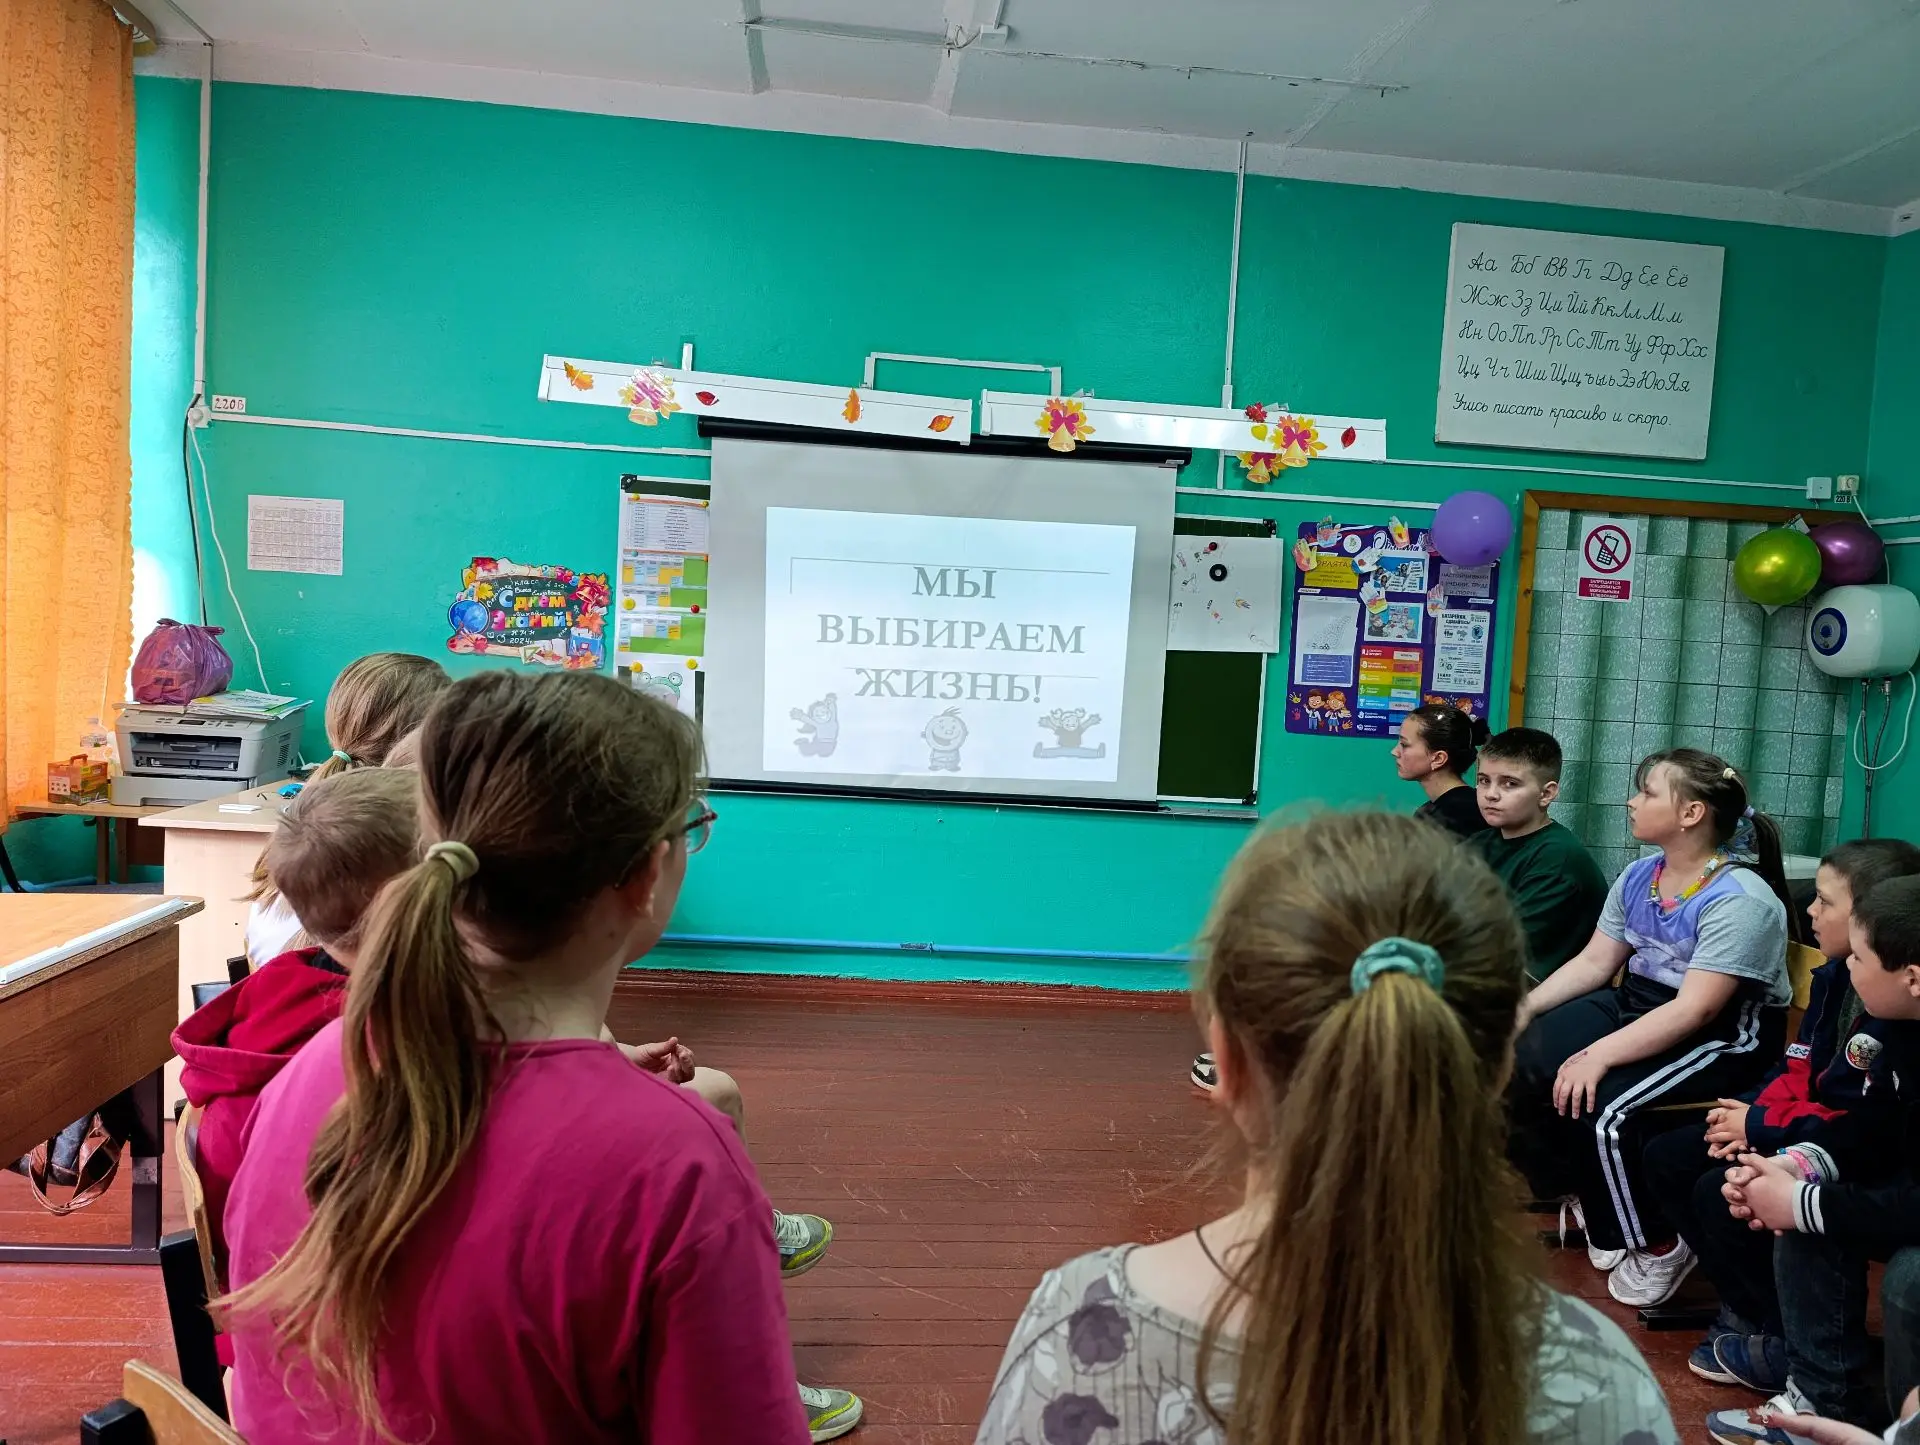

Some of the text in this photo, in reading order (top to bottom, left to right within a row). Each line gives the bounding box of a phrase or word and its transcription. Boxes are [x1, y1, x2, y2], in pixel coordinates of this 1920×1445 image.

[1452, 392, 1672, 433] Учись писать красиво и скоро.
[911, 565, 998, 599] МЫ
[816, 613, 1086, 654] ВЫБИРАЕМ
[853, 668, 1043, 704] ЖИЗНЬ!
